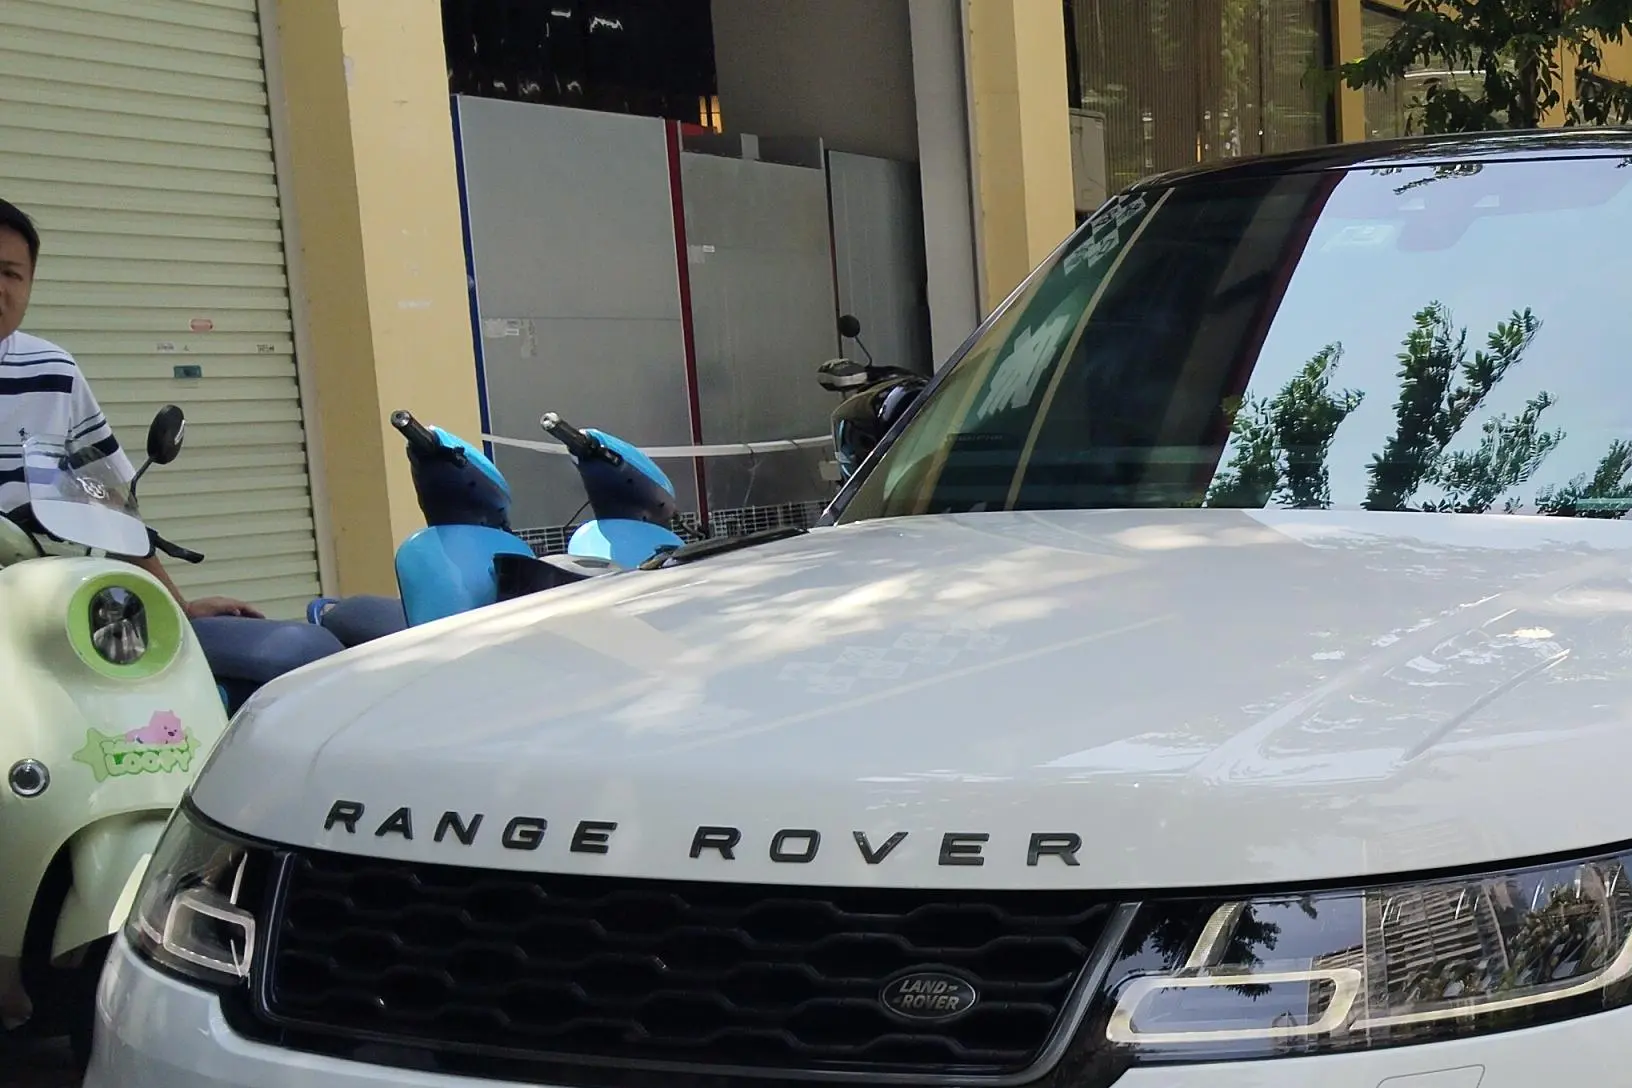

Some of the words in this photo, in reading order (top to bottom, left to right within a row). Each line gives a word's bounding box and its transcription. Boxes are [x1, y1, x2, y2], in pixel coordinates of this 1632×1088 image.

[323, 799, 619, 855] RANGE
[689, 824, 1084, 868] ROVER
[899, 979, 949, 994] LAND
[900, 994, 960, 1010] ROVER
